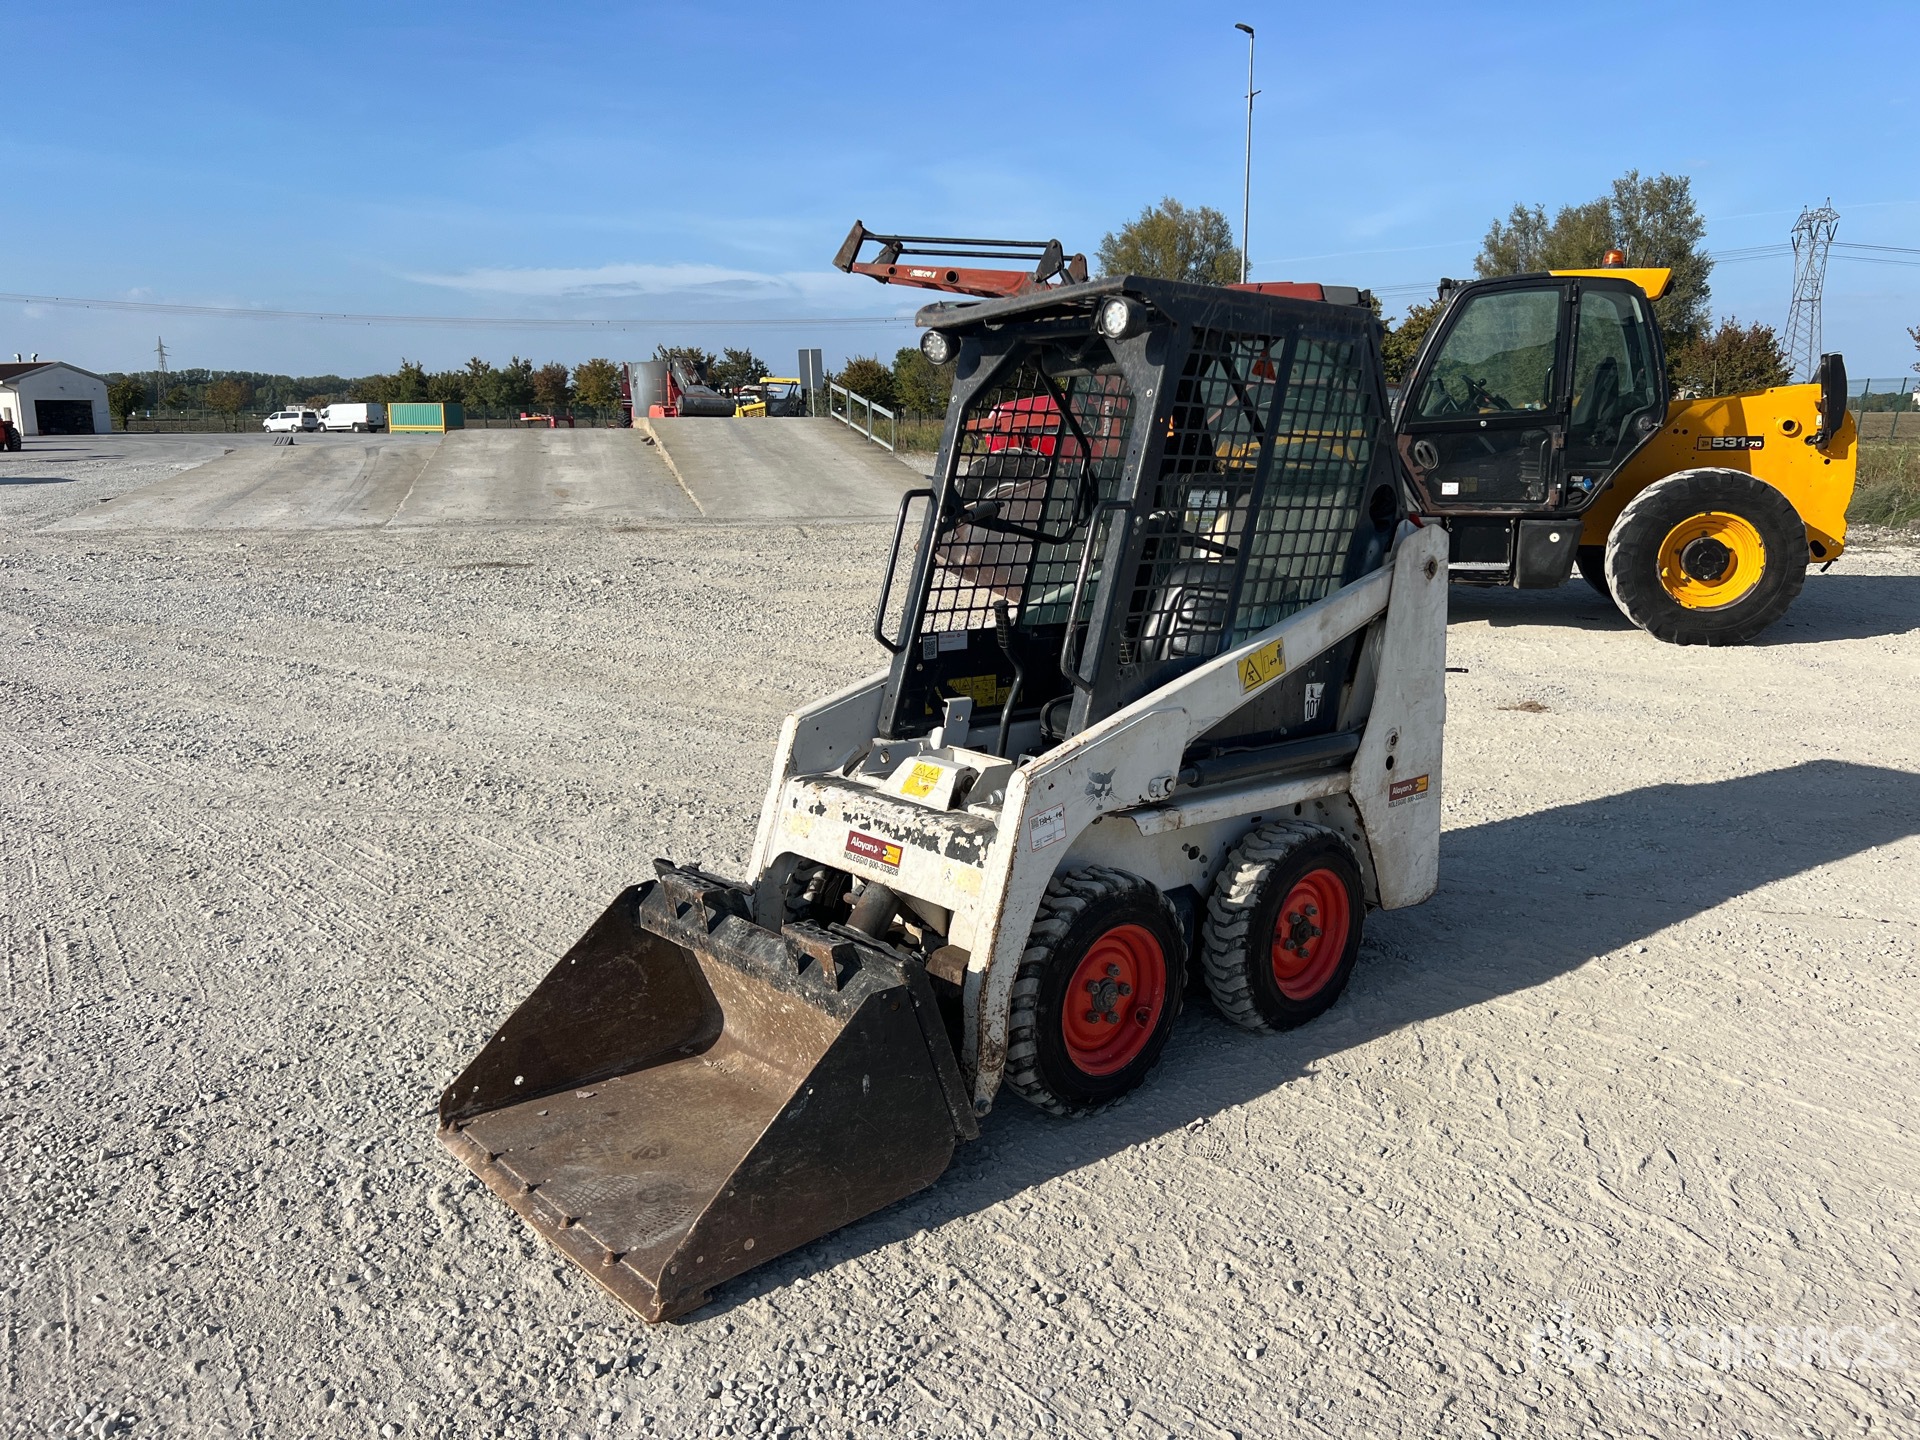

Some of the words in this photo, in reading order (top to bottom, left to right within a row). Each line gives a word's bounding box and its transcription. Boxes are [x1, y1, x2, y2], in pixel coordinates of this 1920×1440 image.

[1712, 437, 1762, 448] 531-70
[851, 836, 875, 853] Alayan
[844, 851, 869, 866] NOLEGGIO
